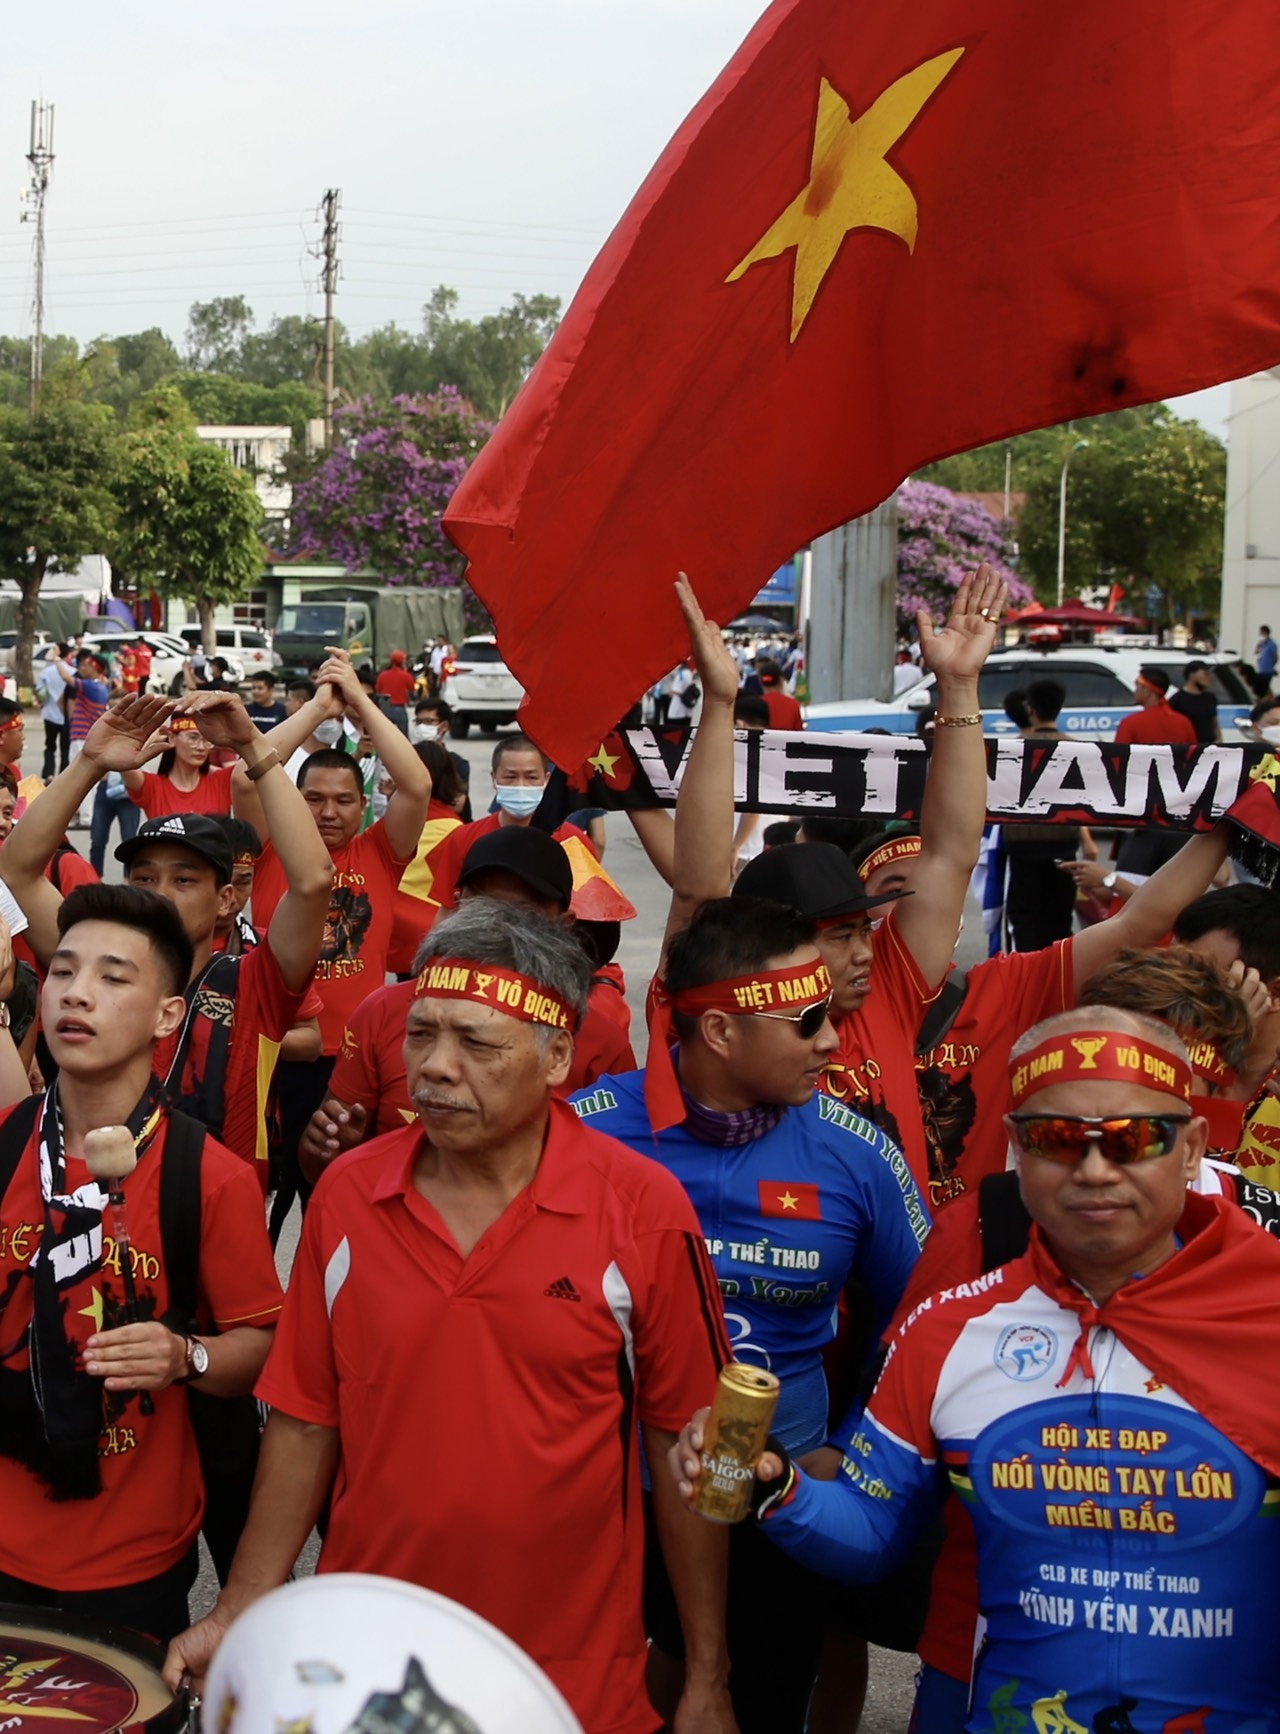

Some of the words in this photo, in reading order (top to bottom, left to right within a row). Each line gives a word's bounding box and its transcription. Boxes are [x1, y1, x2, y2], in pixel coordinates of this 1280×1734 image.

[1066, 716, 1112, 730] GIAO
[159, 826, 186, 836] adidas
[427, 966, 470, 991] NAM
[496, 978, 522, 1007] VÔ
[523, 990, 561, 1025] ĐỊCH
[733, 981, 774, 1010] VIỆT
[777, 974, 819, 1002] NAM
[1030, 1050, 1064, 1077] NAM
[1116, 1046, 1140, 1069] VÔ
[1143, 1053, 1176, 1088] ĐỊCH
[818, 1094, 877, 1146] Vĩnh
[728, 1237, 769, 1264] THỂ
[770, 1247, 820, 1270] THAO
[939, 1267, 1004, 1304] XANH
[1041, 1422, 1079, 1452] HỘI
[1085, 1428, 1112, 1449] XE
[1118, 1429, 1168, 1455] ĐẠP
[700, 1453, 755, 1480] SAIGON
[720, 1454, 740, 1467] BIA
[991, 1453, 1035, 1490] NỐI
[1040, 1457, 1110, 1494] VÒNG
[1115, 1467, 1166, 1496] TAY
[1175, 1463, 1234, 1500] LỚN
[712, 1477, 736, 1492] GOLD
[1045, 1499, 1114, 1530] MIỀN
[1118, 1501, 1176, 1534] BẮC
[1040, 1564, 1066, 1583] CLB
[1071, 1567, 1088, 1585] XE
[1093, 1569, 1120, 1592] ĐẠP
[1124, 1567, 1156, 1591] THỂ
[1158, 1575, 1200, 1594] THAO
[1019, 1587, 1075, 1627] VĨNH
[1083, 1596, 1138, 1634] YÊN
[1148, 1606, 1233, 1638] XANH
